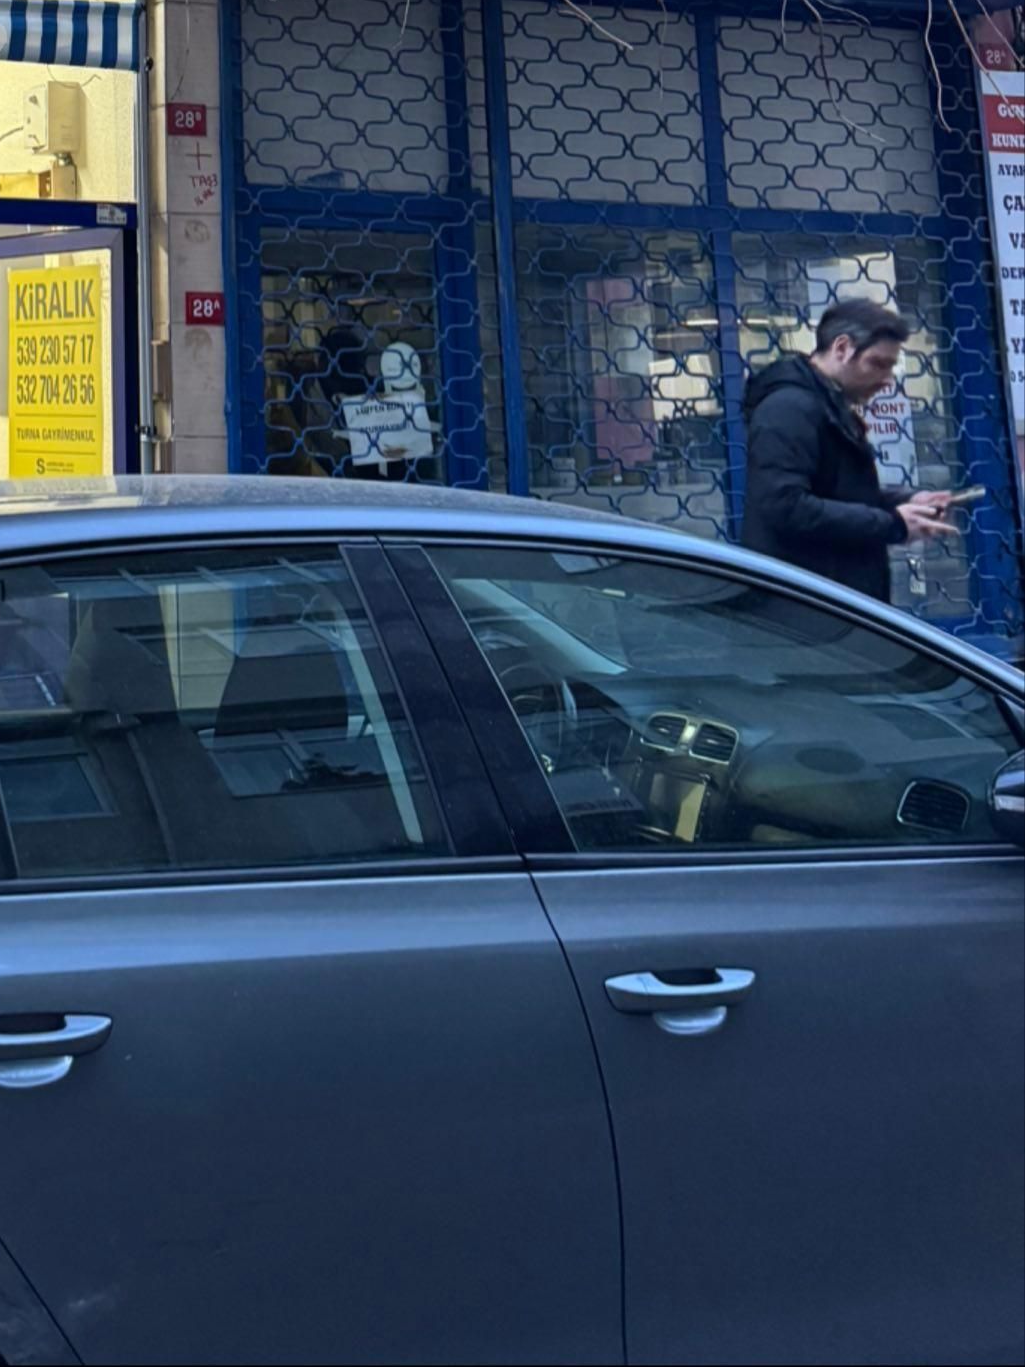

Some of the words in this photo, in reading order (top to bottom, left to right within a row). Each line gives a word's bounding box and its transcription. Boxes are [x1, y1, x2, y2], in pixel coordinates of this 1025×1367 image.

[193, 299, 220, 317] 28A
[17, 336, 37, 365] 539
[40, 335, 60, 365] 230
[63, 335, 77, 364] 57
[81, 334, 94, 364] 17
[17, 375, 37, 404] 532
[40, 374, 60, 404] 704
[63, 374, 77, 404] 26
[80, 374, 95, 404] 56
